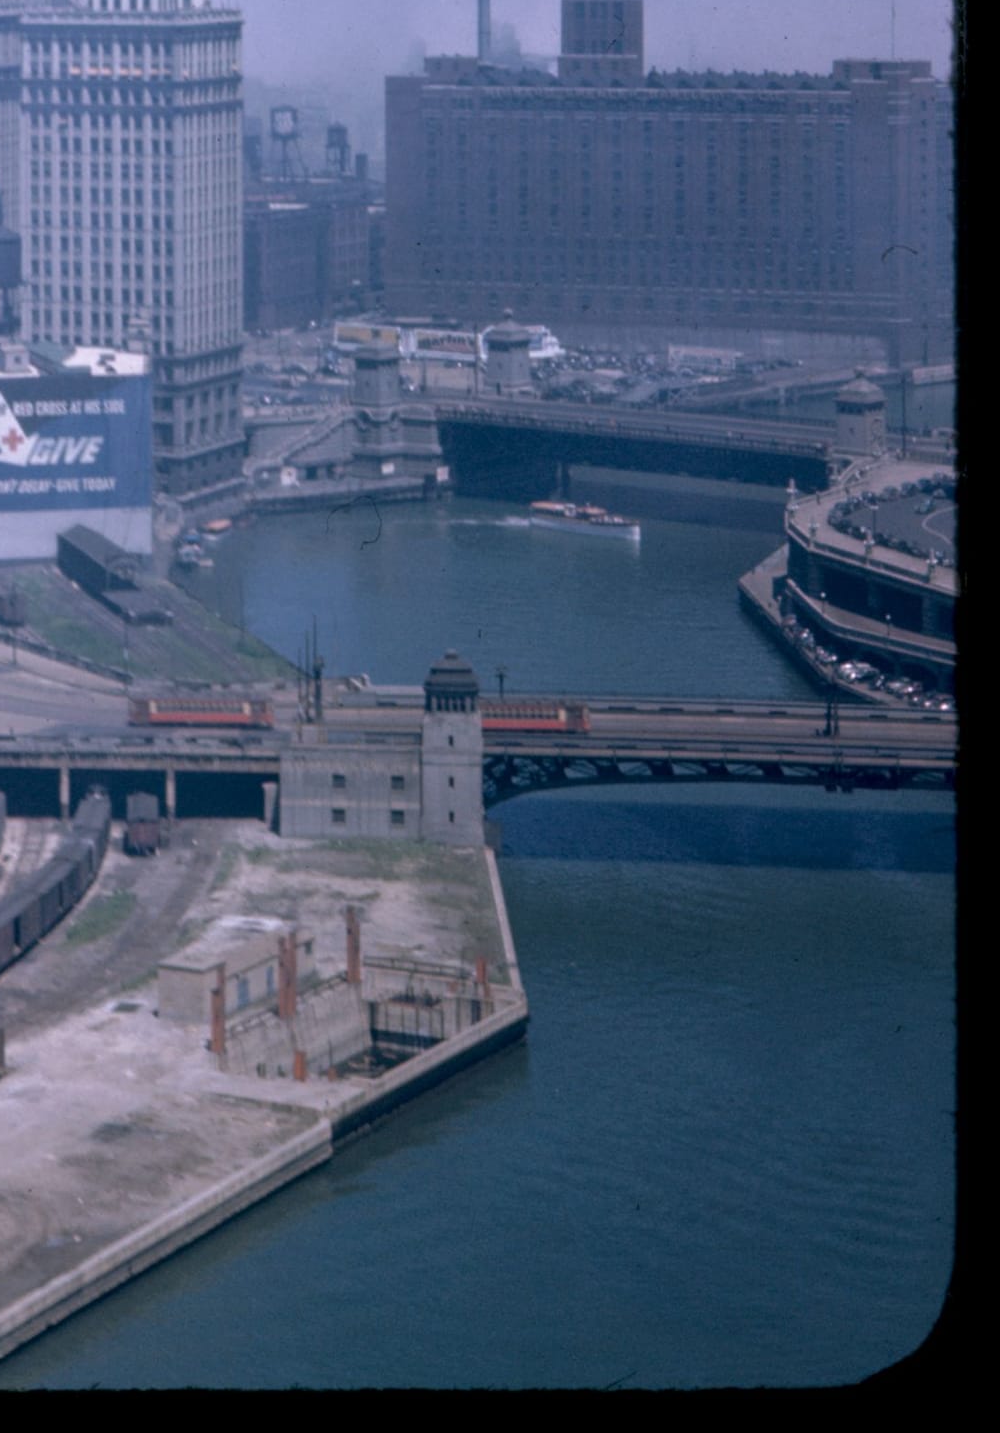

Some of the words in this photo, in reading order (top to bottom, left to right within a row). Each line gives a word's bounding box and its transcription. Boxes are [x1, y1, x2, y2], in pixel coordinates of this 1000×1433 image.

[12, 401, 34, 416] RED
[35, 400, 67, 416] CROSS
[70, 400, 82, 415] AT
[84, 399, 101, 414] HIS
[103, 398, 126, 414] SIDE
[28, 435, 104, 465] GIVE
[82, 476, 117, 492] TODAY
